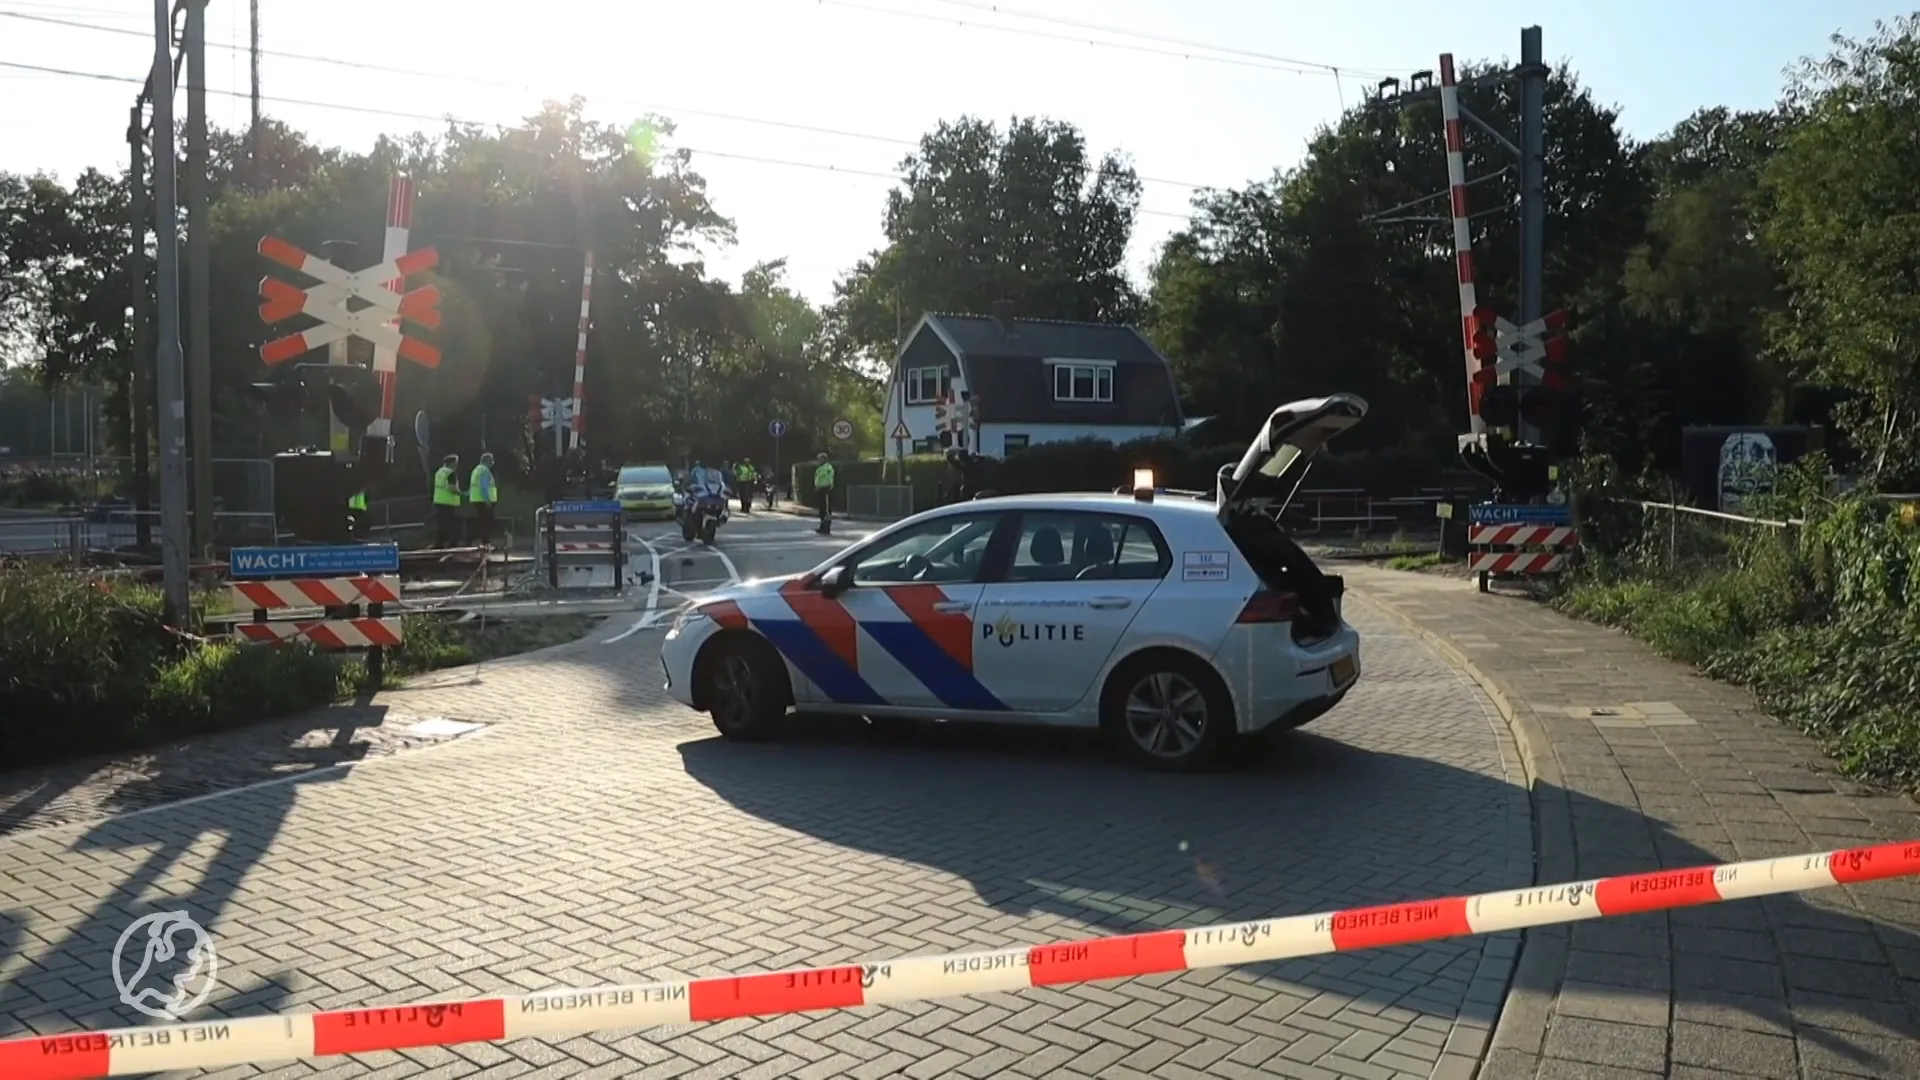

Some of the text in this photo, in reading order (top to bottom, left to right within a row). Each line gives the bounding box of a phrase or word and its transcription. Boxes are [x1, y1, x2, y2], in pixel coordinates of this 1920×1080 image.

[836, 424, 850, 434] 30
[1471, 508, 1519, 519] WACHT
[236, 553, 307, 570] WACHT
[982, 623, 1084, 648] POLITIE
